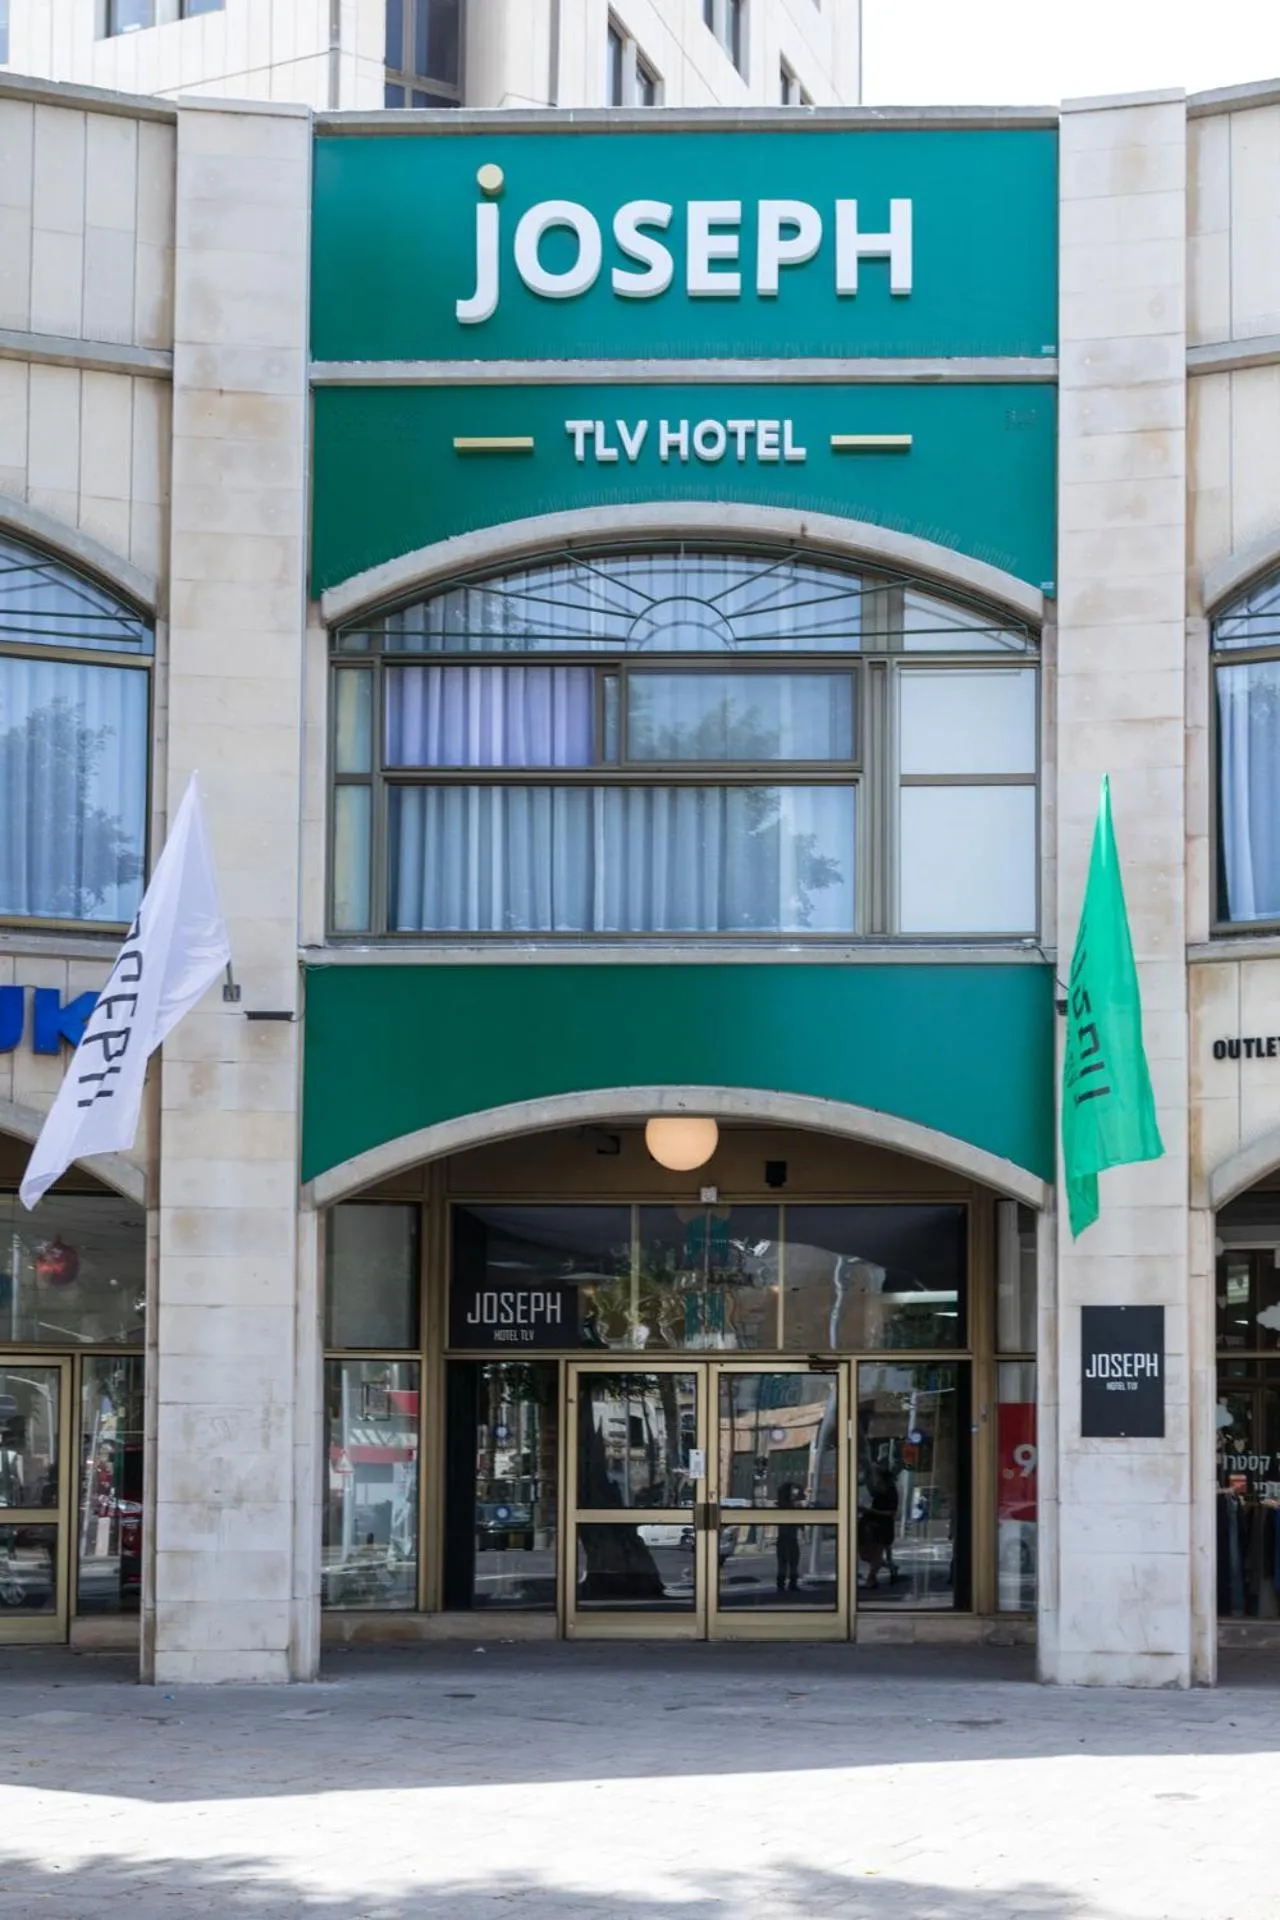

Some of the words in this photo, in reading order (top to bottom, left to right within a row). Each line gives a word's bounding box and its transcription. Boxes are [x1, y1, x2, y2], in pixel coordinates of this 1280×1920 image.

[565, 419, 648, 462] TLV
[659, 419, 807, 462] HOTEL
[1213, 1037, 1280, 1060] OUTLE
[466, 1291, 562, 1324] JOSEPH
[1085, 1352, 1159, 1378] JOSEPH
[1223, 1454, 1272, 1476] קסטרו
